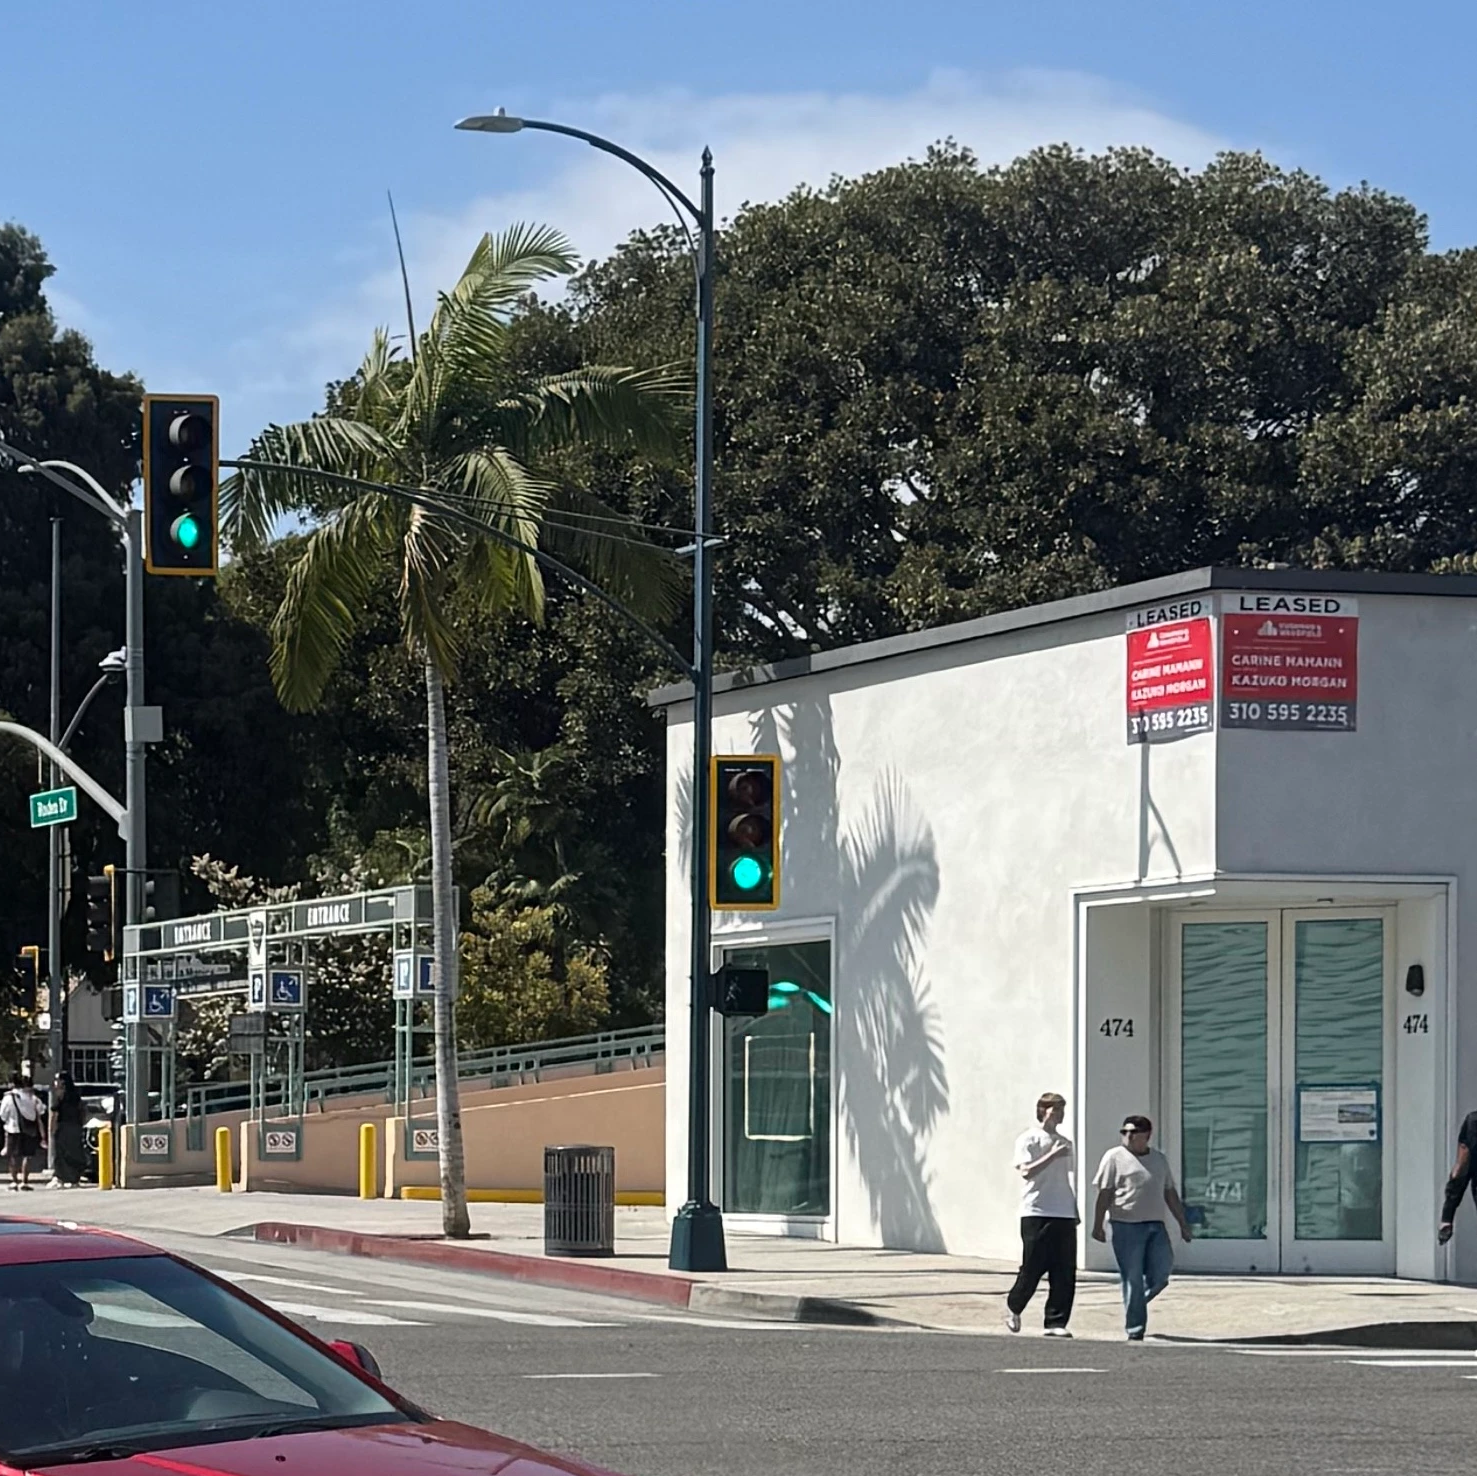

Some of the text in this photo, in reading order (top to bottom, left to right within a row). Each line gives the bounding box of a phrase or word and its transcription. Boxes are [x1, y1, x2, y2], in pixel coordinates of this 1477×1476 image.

[1136, 600, 1202, 628] LEASED
[1239, 595, 1341, 614] LEASED
[1231, 654, 1282, 667] CARINE
[1151, 711, 1175, 731] 595
[1176, 706, 1208, 728] 2235
[1229, 702, 1348, 723] 310 595 2235
[306, 902, 350, 928] ENTRANCE
[174, 921, 212, 945] ENTRANCE
[399, 961, 409, 987] P
[254, 977, 262, 1000] P
[1099, 1018, 1134, 1037] 474
[1403, 1014, 1429, 1034] 474
[1205, 1181, 1242, 1202] 474
